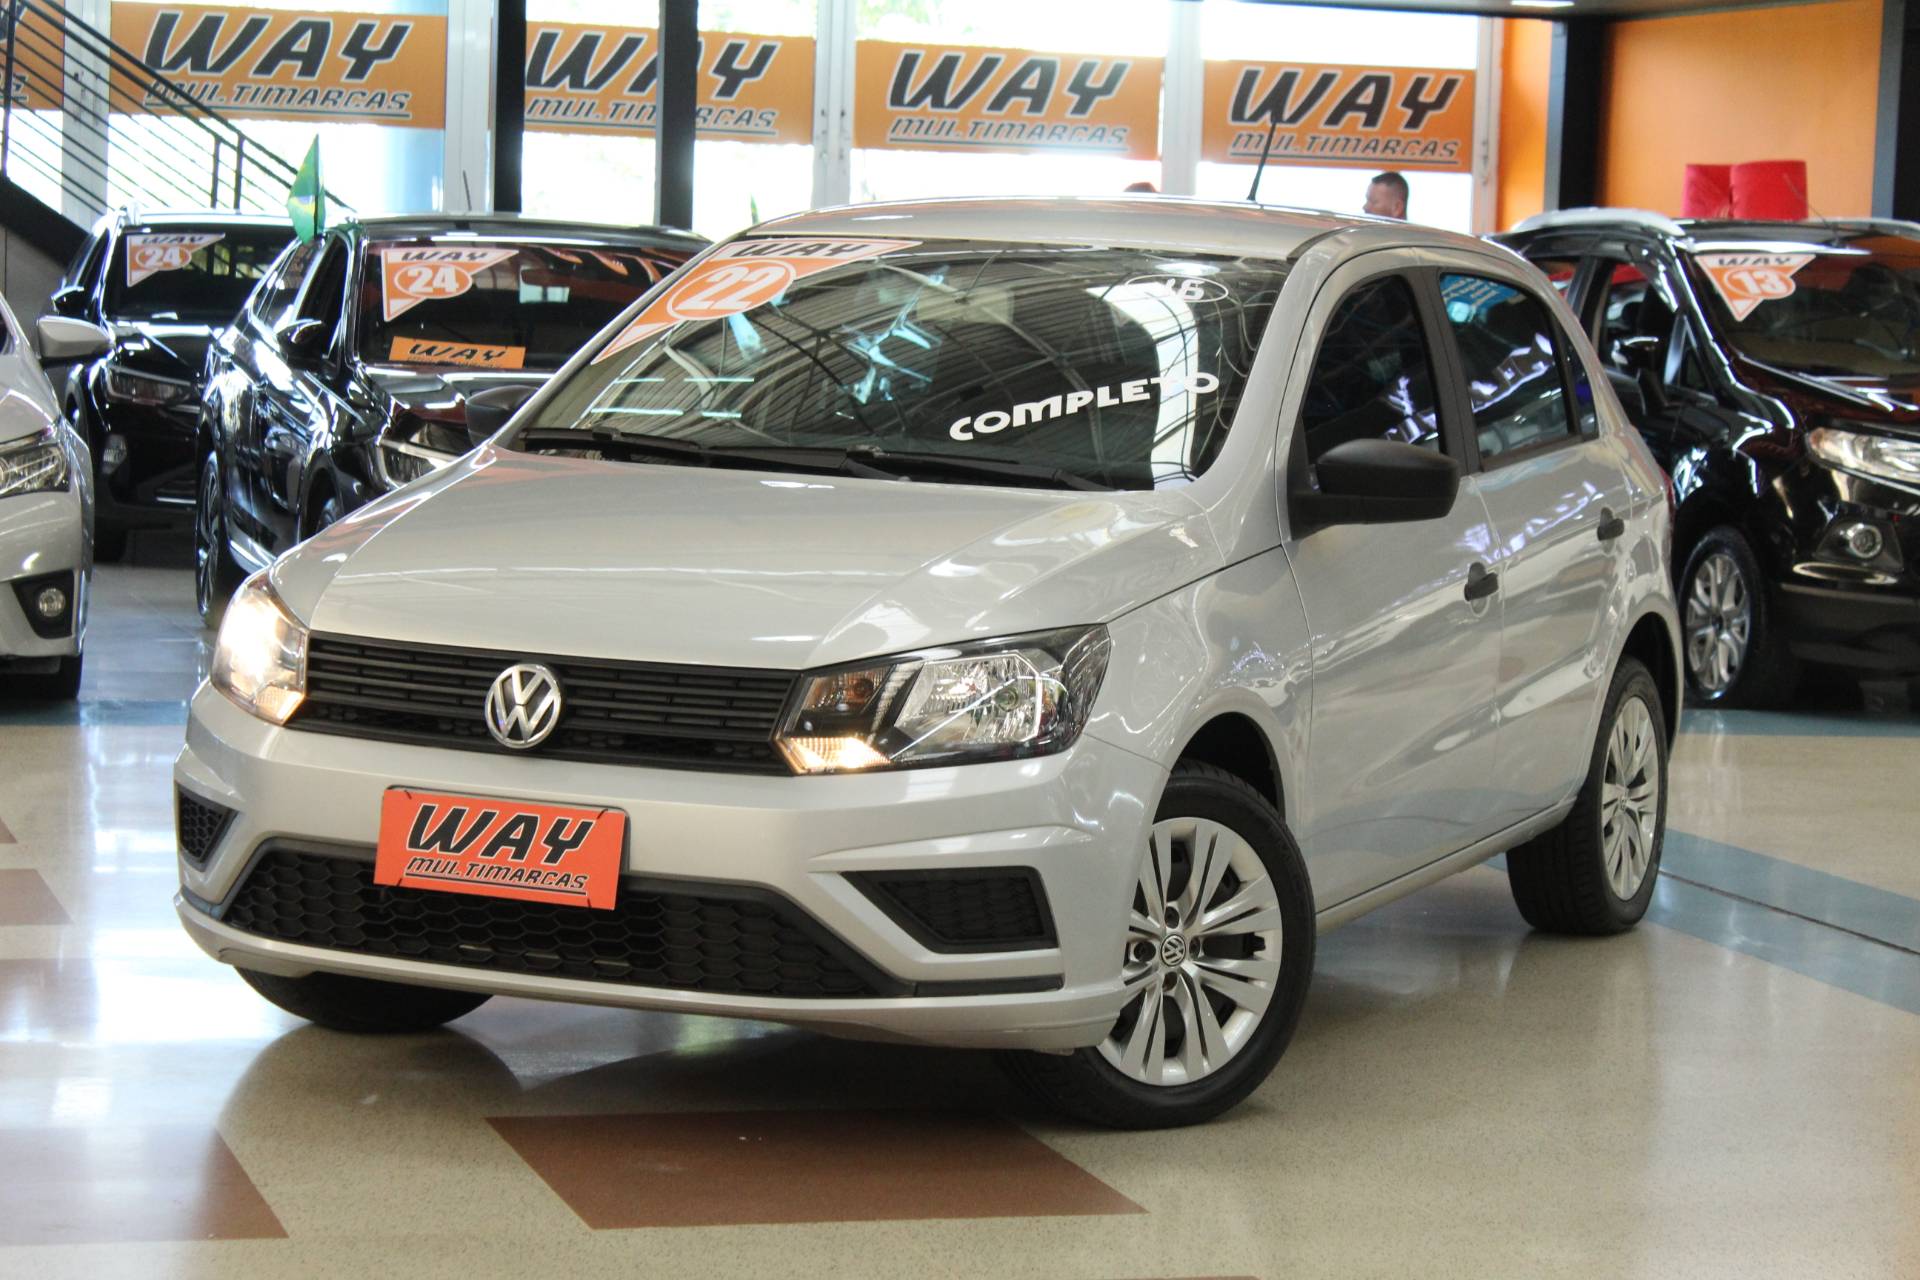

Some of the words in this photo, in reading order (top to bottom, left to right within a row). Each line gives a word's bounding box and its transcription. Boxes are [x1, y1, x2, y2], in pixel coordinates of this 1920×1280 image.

[144, 9, 413, 82] WAY
[887, 49, 1132, 118] WAY
[1228, 67, 1462, 131] WAY
[143, 247, 182, 266] 24
[402, 251, 488, 261] WAY
[731, 243, 871, 257] WAY
[408, 267, 459, 293] 24
[676, 265, 777, 311] 22
[1734, 270, 1783, 295] 13
[409, 344, 507, 360] WAY
[406, 803, 595, 866] WAY
[407, 857, 588, 889] MULTIMARCAS
